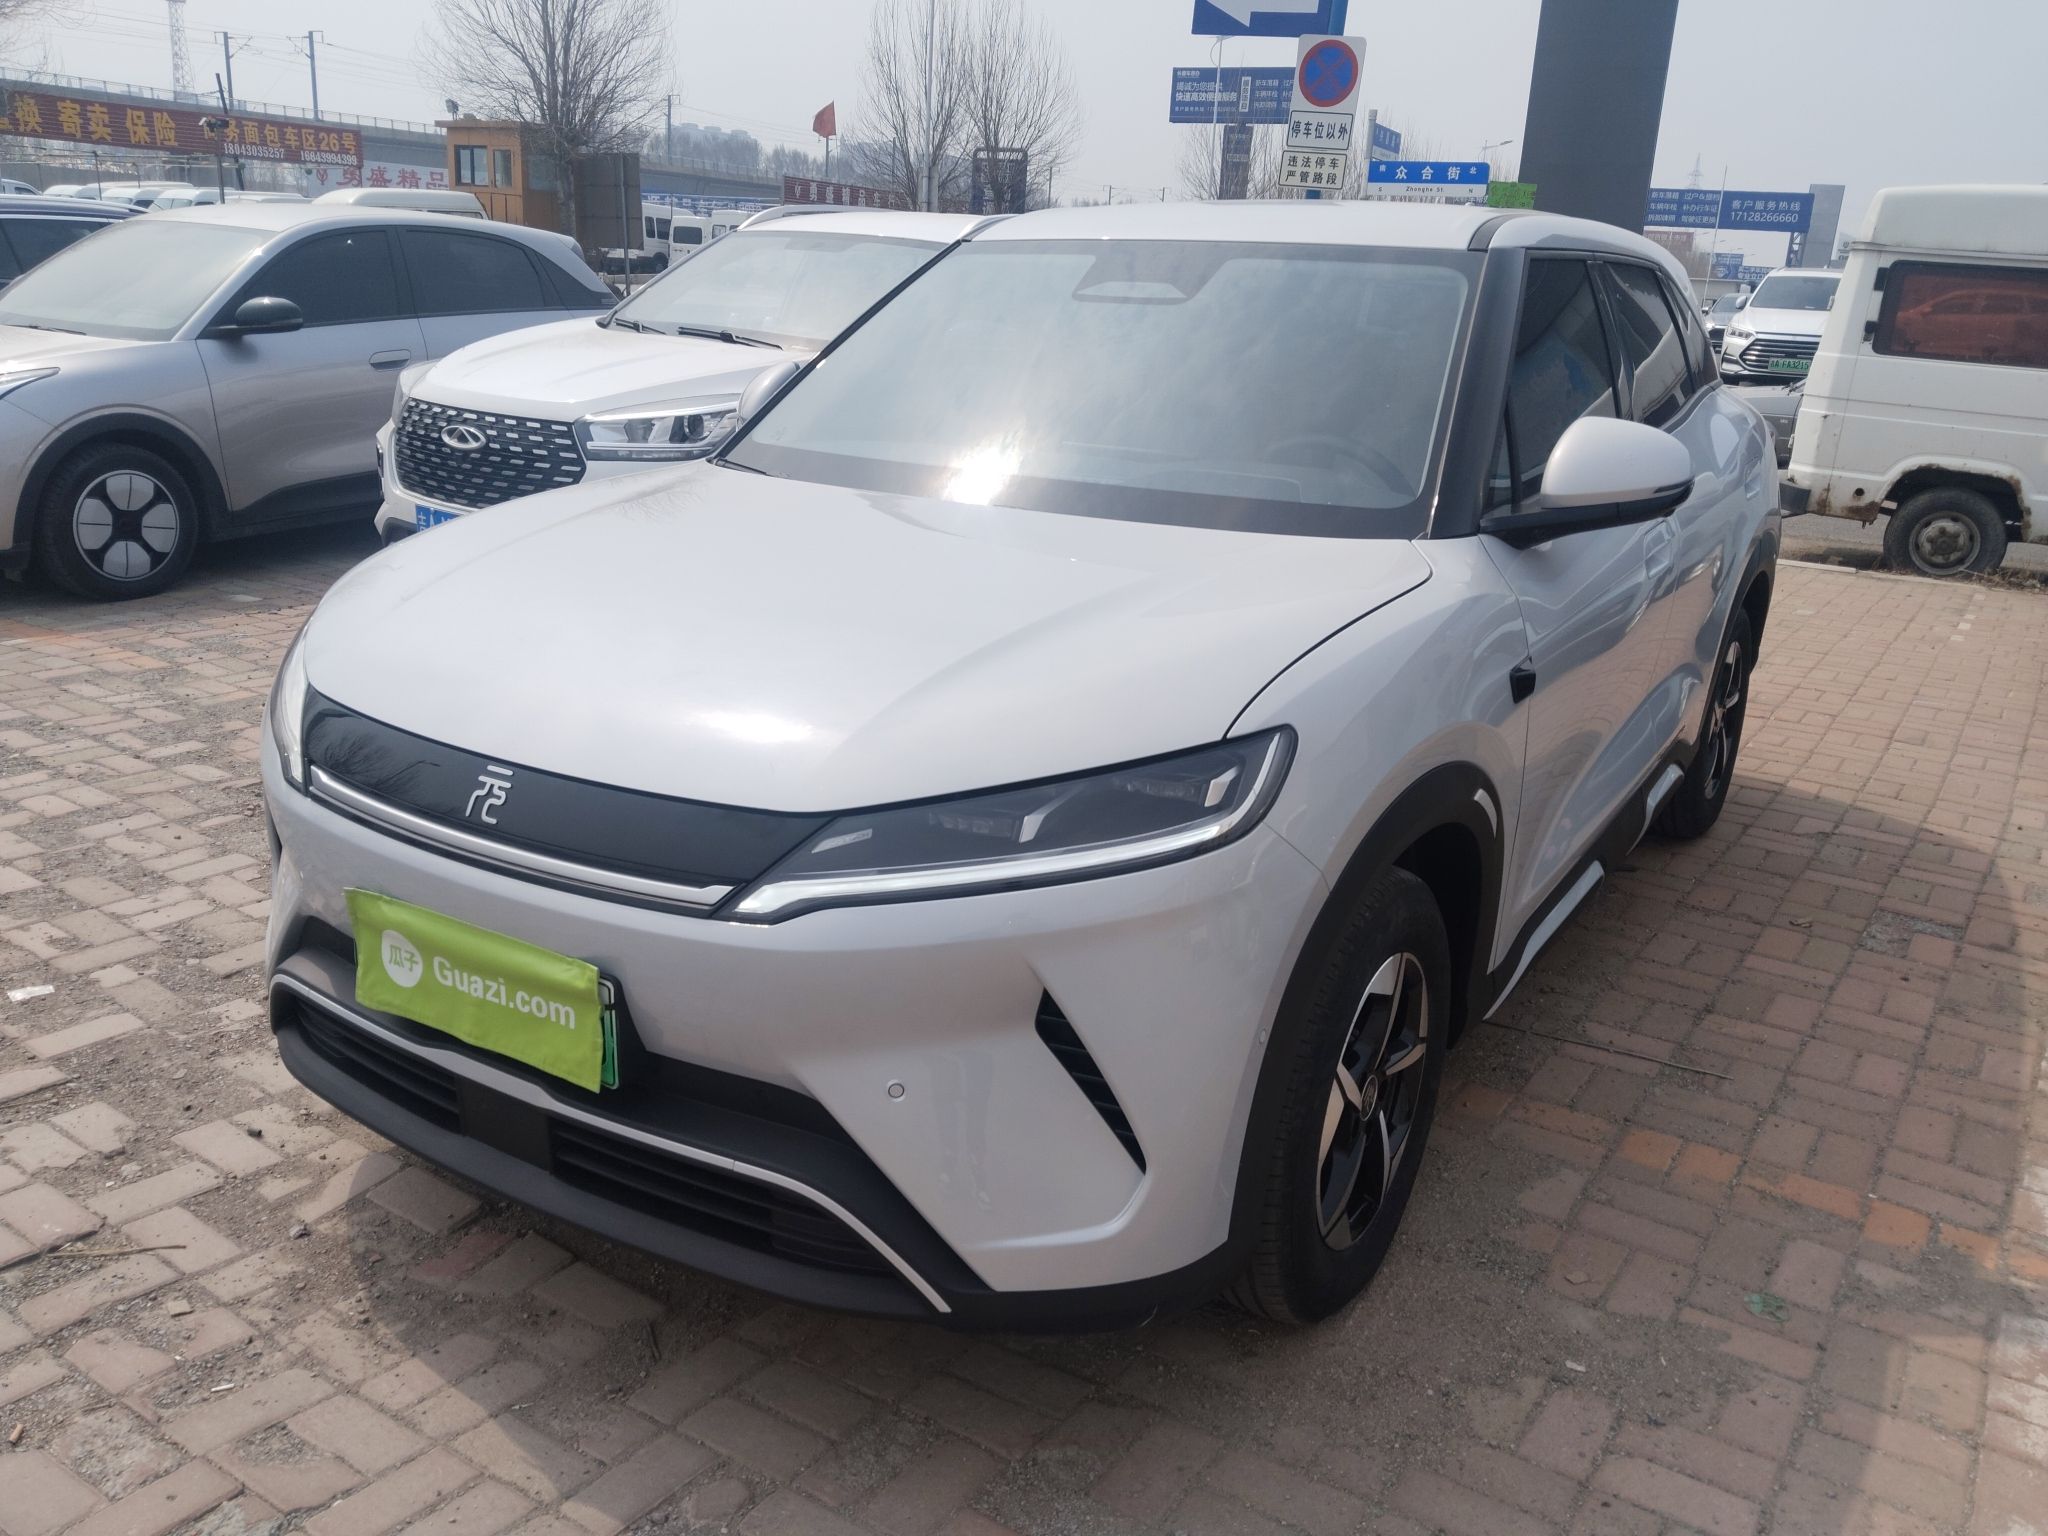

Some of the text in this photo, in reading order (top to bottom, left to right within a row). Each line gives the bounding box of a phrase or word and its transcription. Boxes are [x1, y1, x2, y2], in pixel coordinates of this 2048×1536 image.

[57, 100, 112, 142] 寄卖
[126, 107, 178, 146] 保险
[1291, 120, 1348, 140] 停车位以外
[1287, 155, 1340, 170] 违法停车
[1284, 169, 1338, 185] 严管路段
[1395, 165, 1460, 180] 众合街
[1731, 200, 1801, 212] 客户服务热线
[1730, 211, 1799, 223] 17128266660
[388, 943, 419, 972] 瓜子
[432, 956, 577, 1030] Guazi.com
